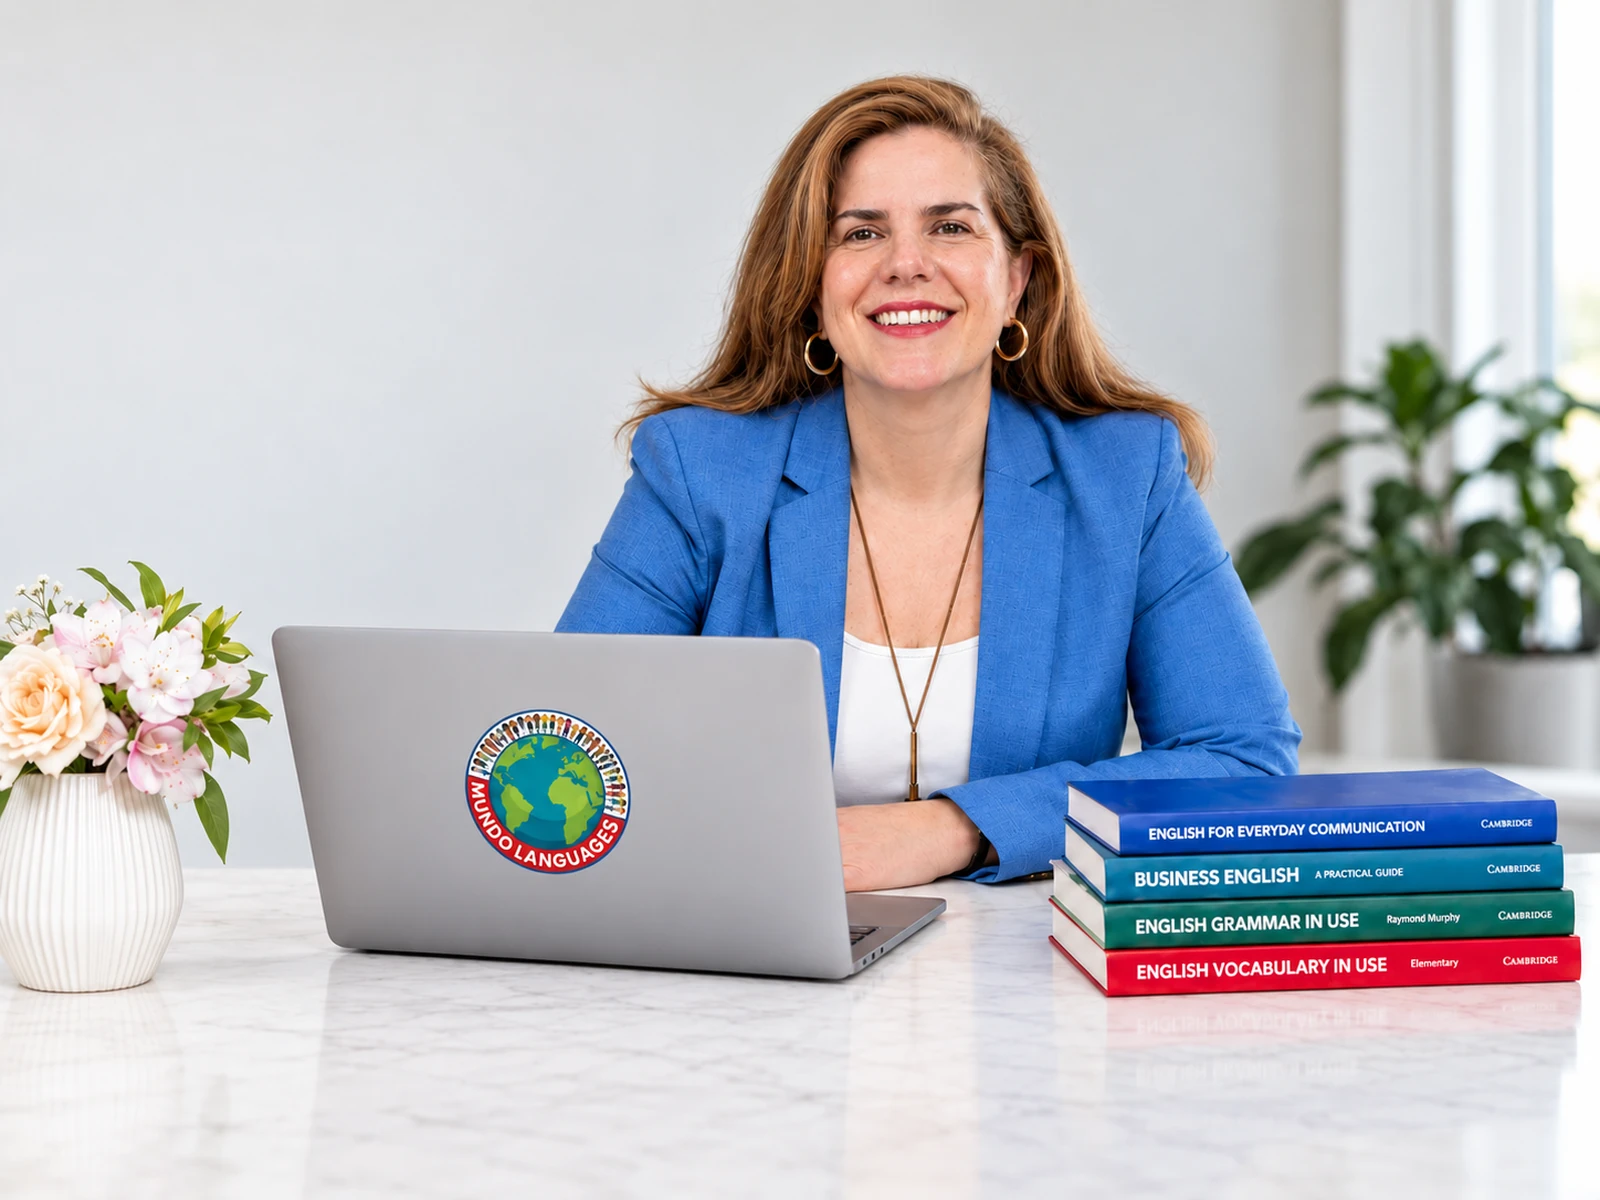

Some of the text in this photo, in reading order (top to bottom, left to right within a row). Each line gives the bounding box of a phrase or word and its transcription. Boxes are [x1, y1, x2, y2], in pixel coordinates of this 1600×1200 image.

[471, 781, 619, 868] MUNDO LANGUAGES
[1148, 820, 1426, 841] ENGLISH FOR EVERYDAY COMMUNICATION
[1134, 866, 1299, 887] BUSINESS ENGLISH
[1314, 867, 1404, 879] A PRACTICAL GUIDE
[1135, 912, 1360, 935] ENGLISH GRAMMAR IN USE
[1386, 912, 1461, 926] Raymond Murphy
[1137, 956, 1388, 980] ENGLISH VOCABULARY IN USE
[1410, 958, 1459, 969] Elementary
